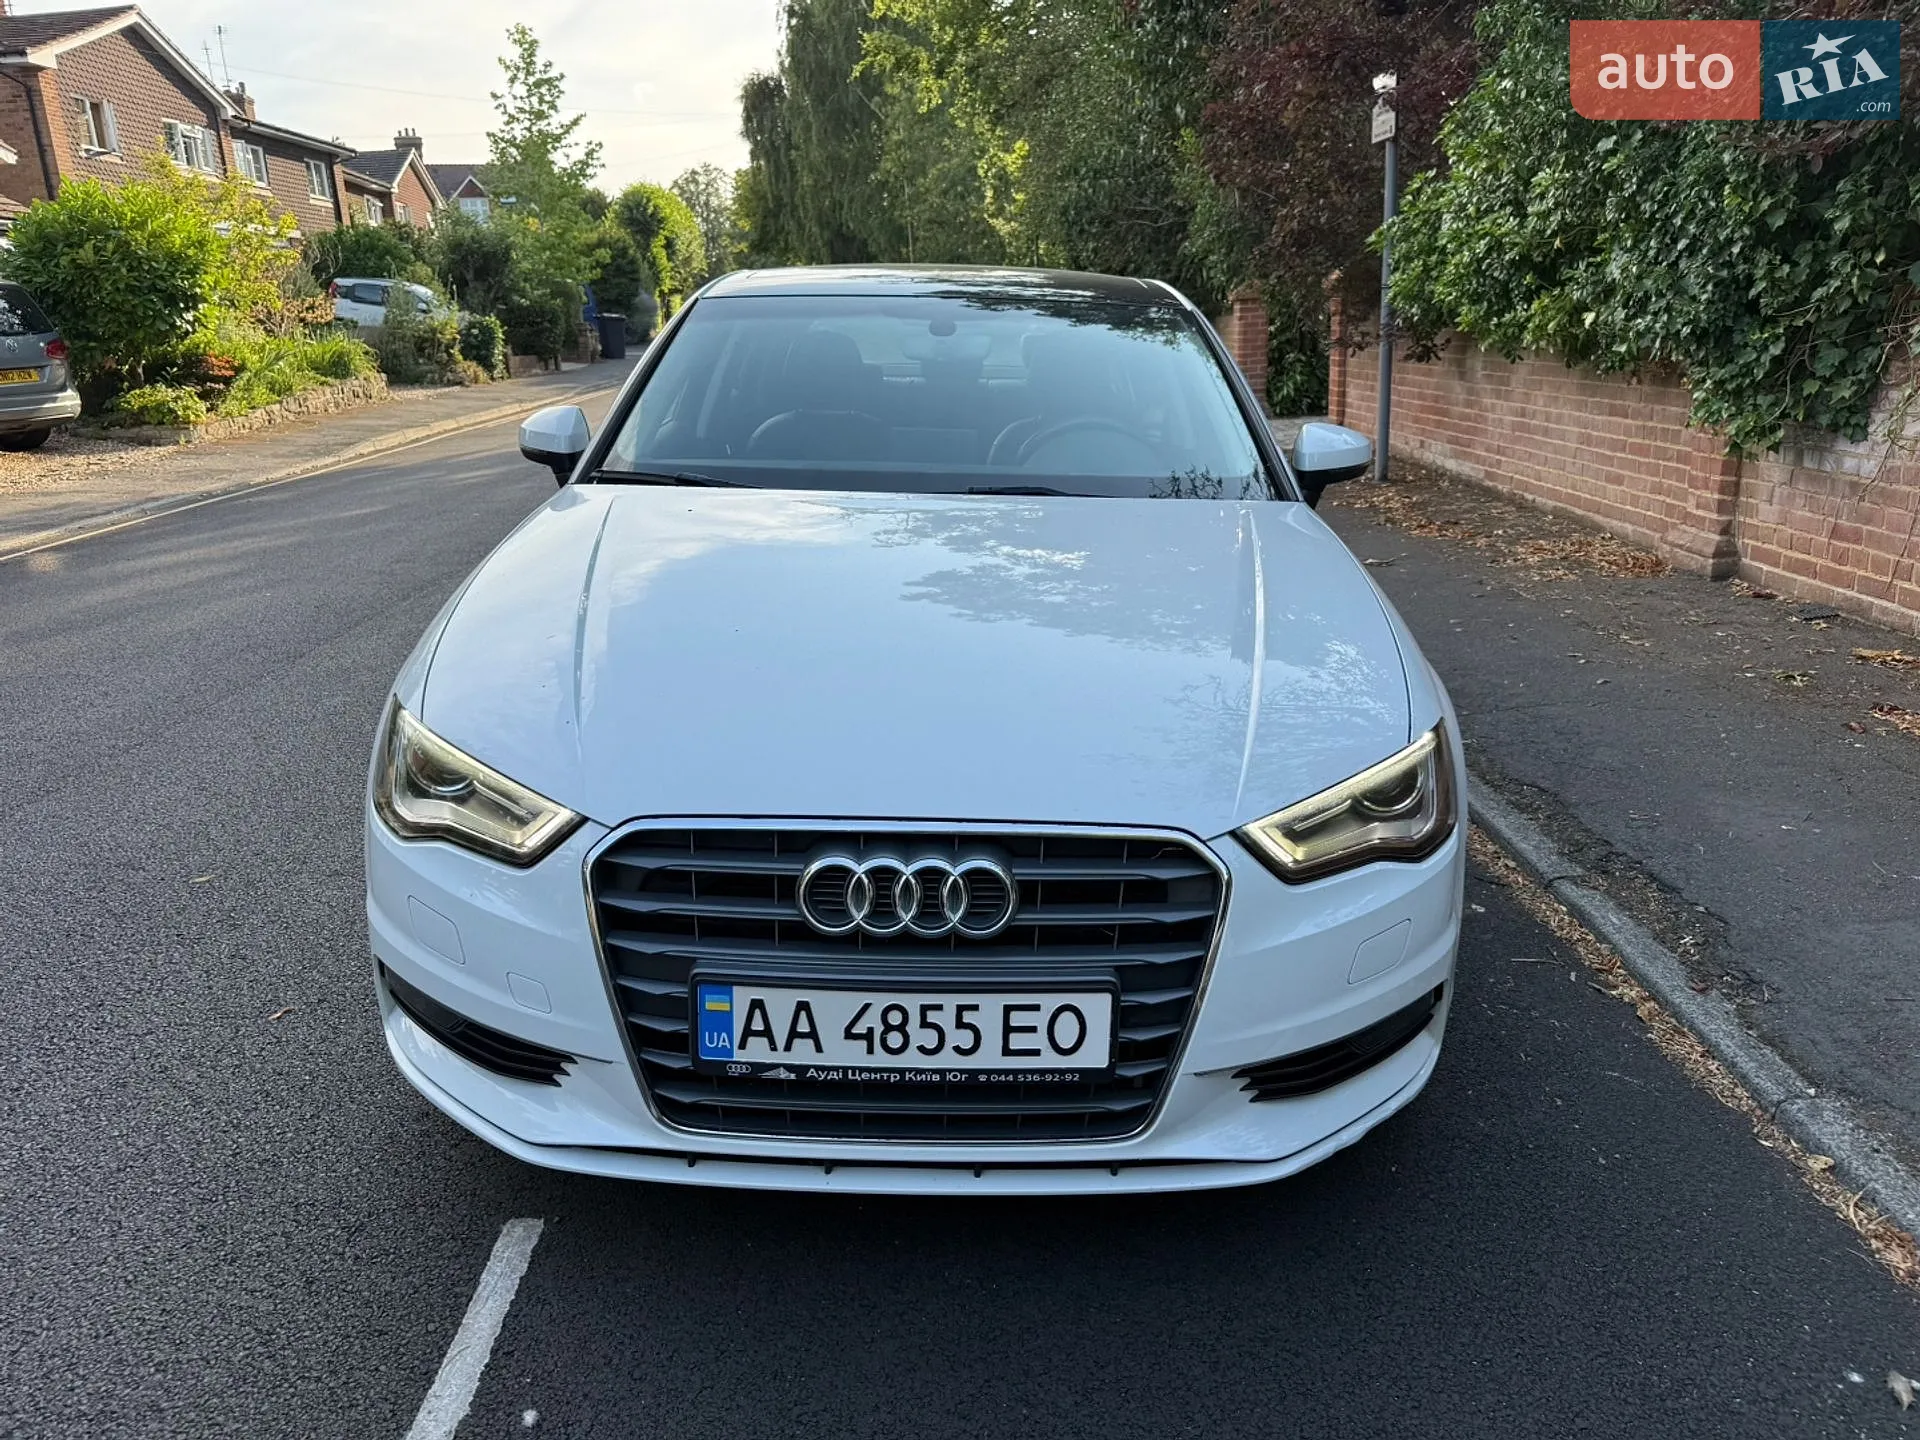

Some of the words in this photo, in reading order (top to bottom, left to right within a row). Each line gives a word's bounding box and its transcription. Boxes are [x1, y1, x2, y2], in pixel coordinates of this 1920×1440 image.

[737, 997, 824, 1054] AA
[843, 1002, 983, 1057] 4855
[1001, 1002, 1088, 1057] EO
[705, 1031, 731, 1049] UA
[806, 1067, 843, 1081] Ауді
[848, 1069, 901, 1083] Центр
[905, 1071, 941, 1082] Київ
[946, 1071, 969, 1082] Юг
[990, 1074, 1014, 1082] 044
